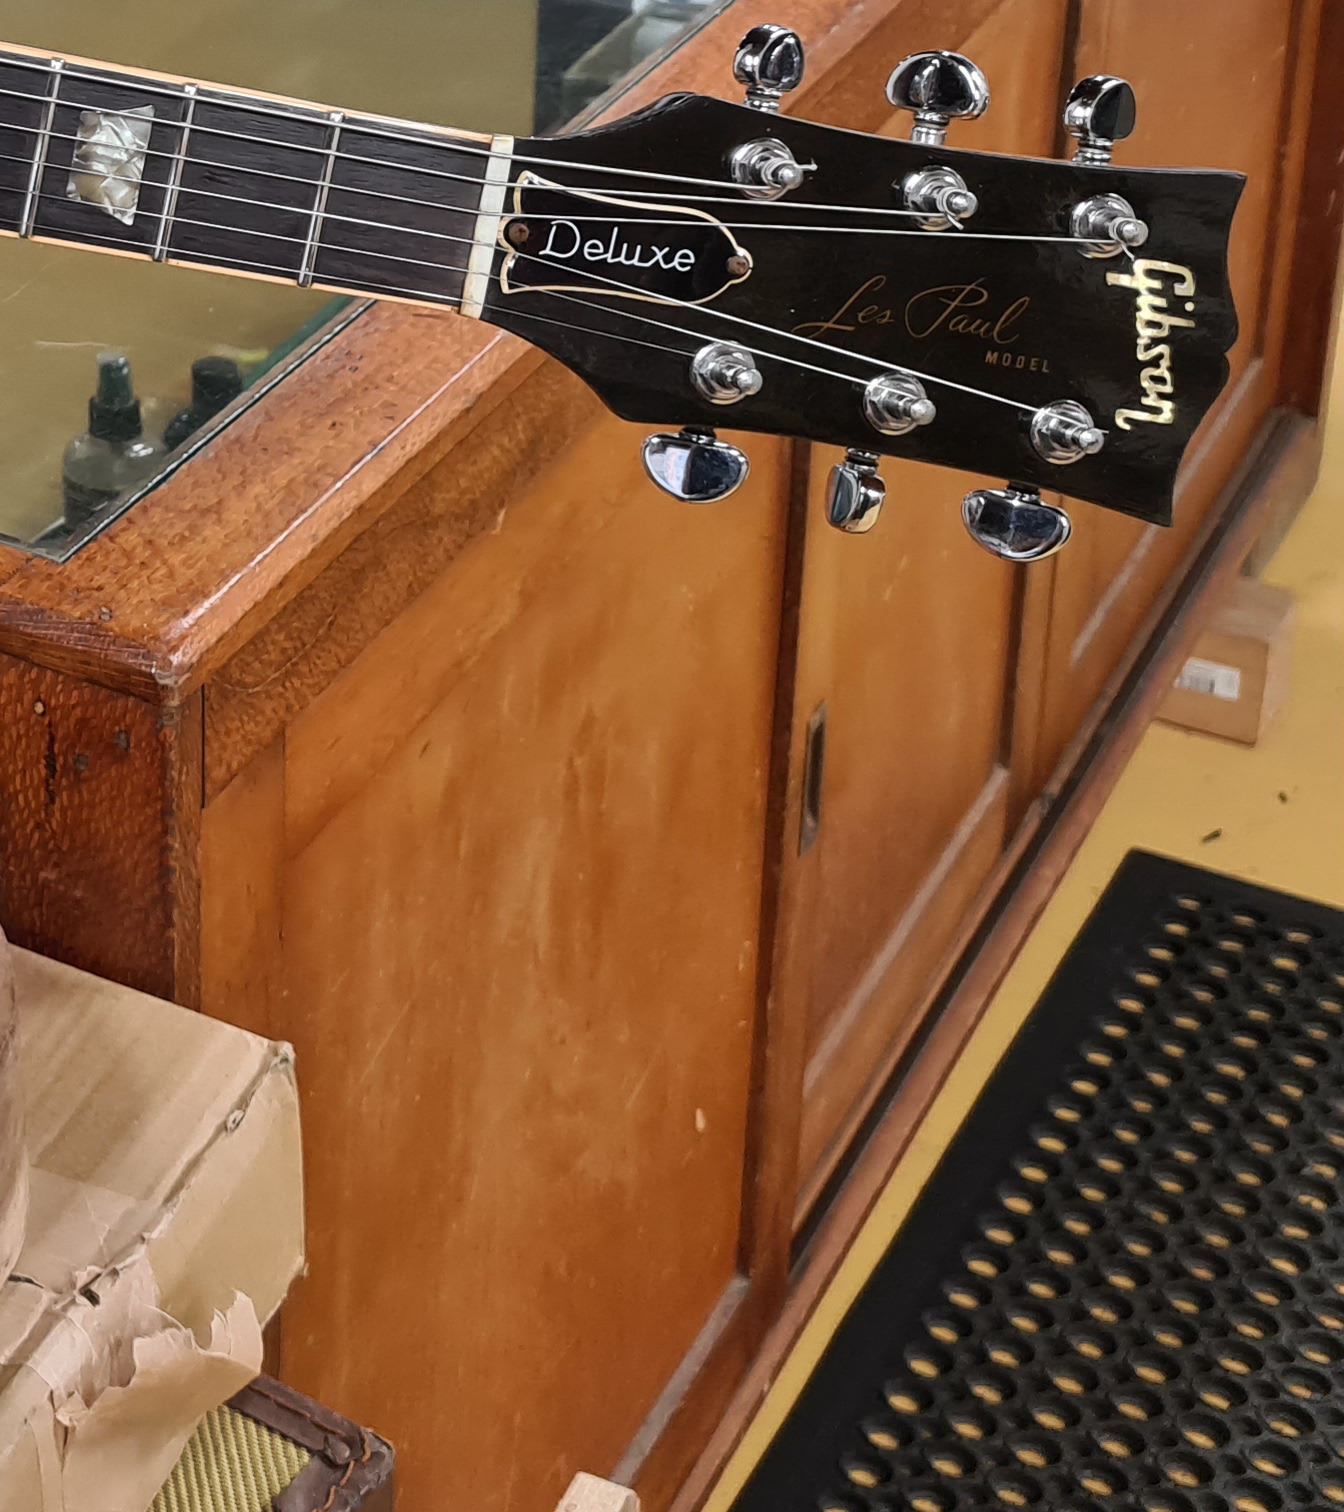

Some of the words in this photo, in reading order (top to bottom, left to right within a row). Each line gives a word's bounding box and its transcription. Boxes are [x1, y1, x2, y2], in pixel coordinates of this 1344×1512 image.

[538, 220, 697, 273] Deluxe
[791, 276, 895, 338] Les
[904, 277, 1030, 344] Paul
[985, 350, 1051, 374] MODEL
[1105, 258, 1196, 431] Gibson
